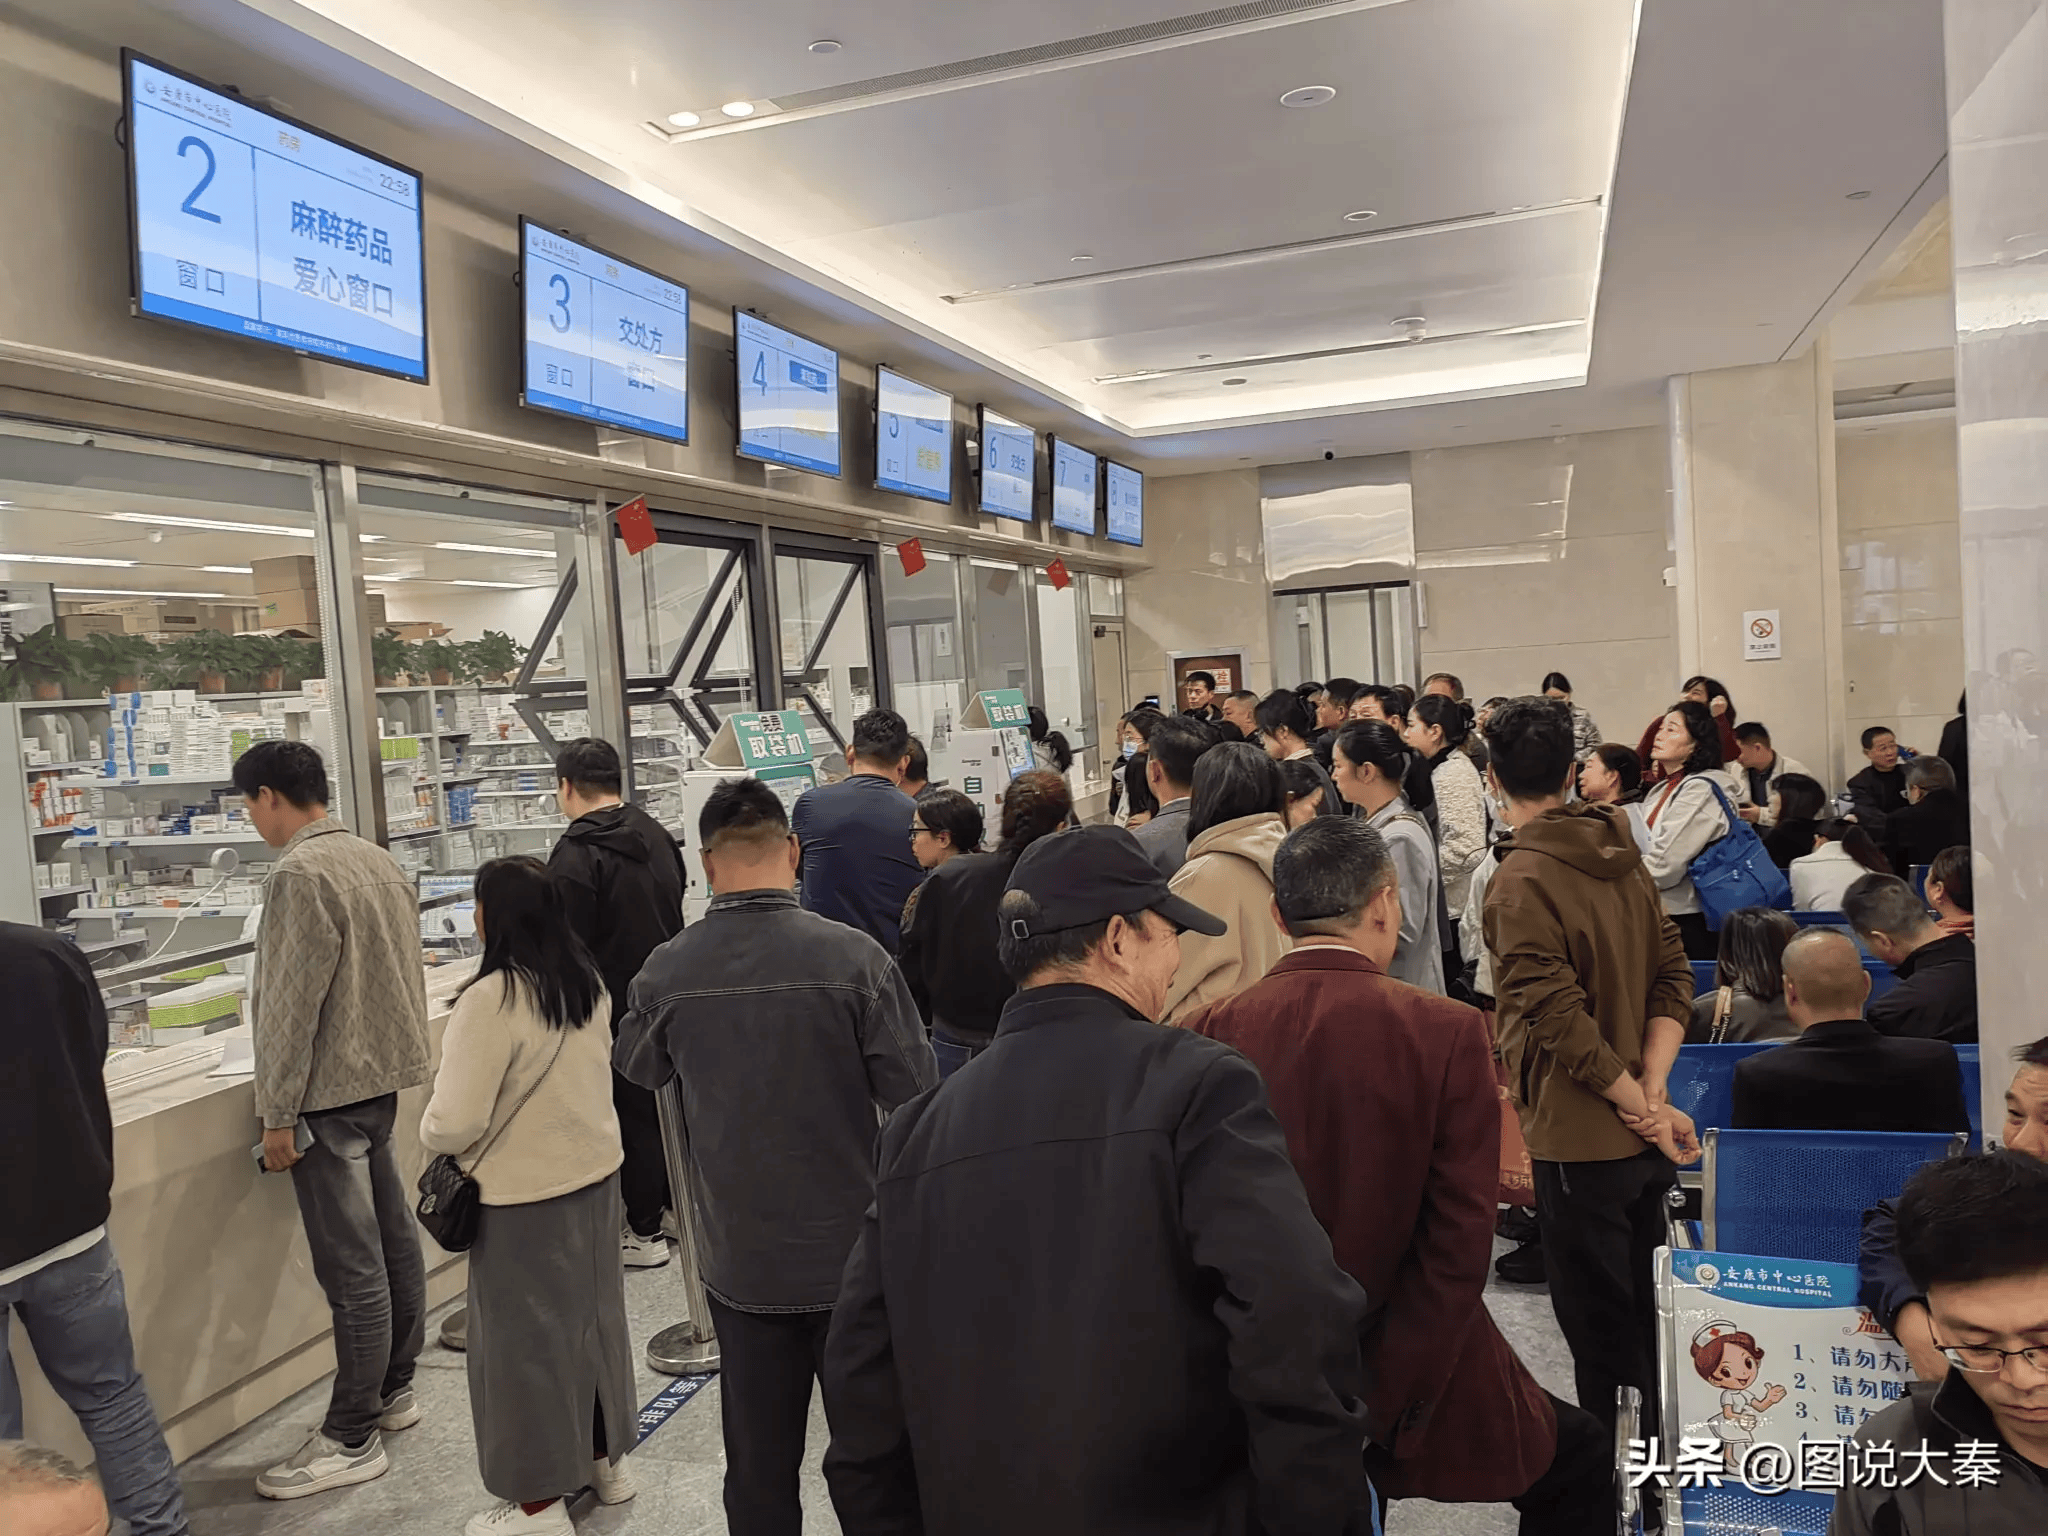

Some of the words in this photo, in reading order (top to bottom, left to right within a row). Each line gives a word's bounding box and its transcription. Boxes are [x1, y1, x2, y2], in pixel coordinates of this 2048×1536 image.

[176, 135, 221, 224] 2
[290, 200, 393, 267] 麻醉药品
[176, 259, 225, 296] 窗口
[293, 256, 394, 318] 爱心窗口
[548, 273, 572, 334] 3
[618, 316, 663, 354] 交处方
[752, 350, 767, 396] 4
[989, 436, 997, 468] 6
[1722, 1265, 1831, 1288] 安康市中心医院
[1723, 1281, 1754, 1290] ANKANG
[1757, 1284, 1791, 1293] CENTRAL
[1794, 1288, 1832, 1298] HOSPITAL
